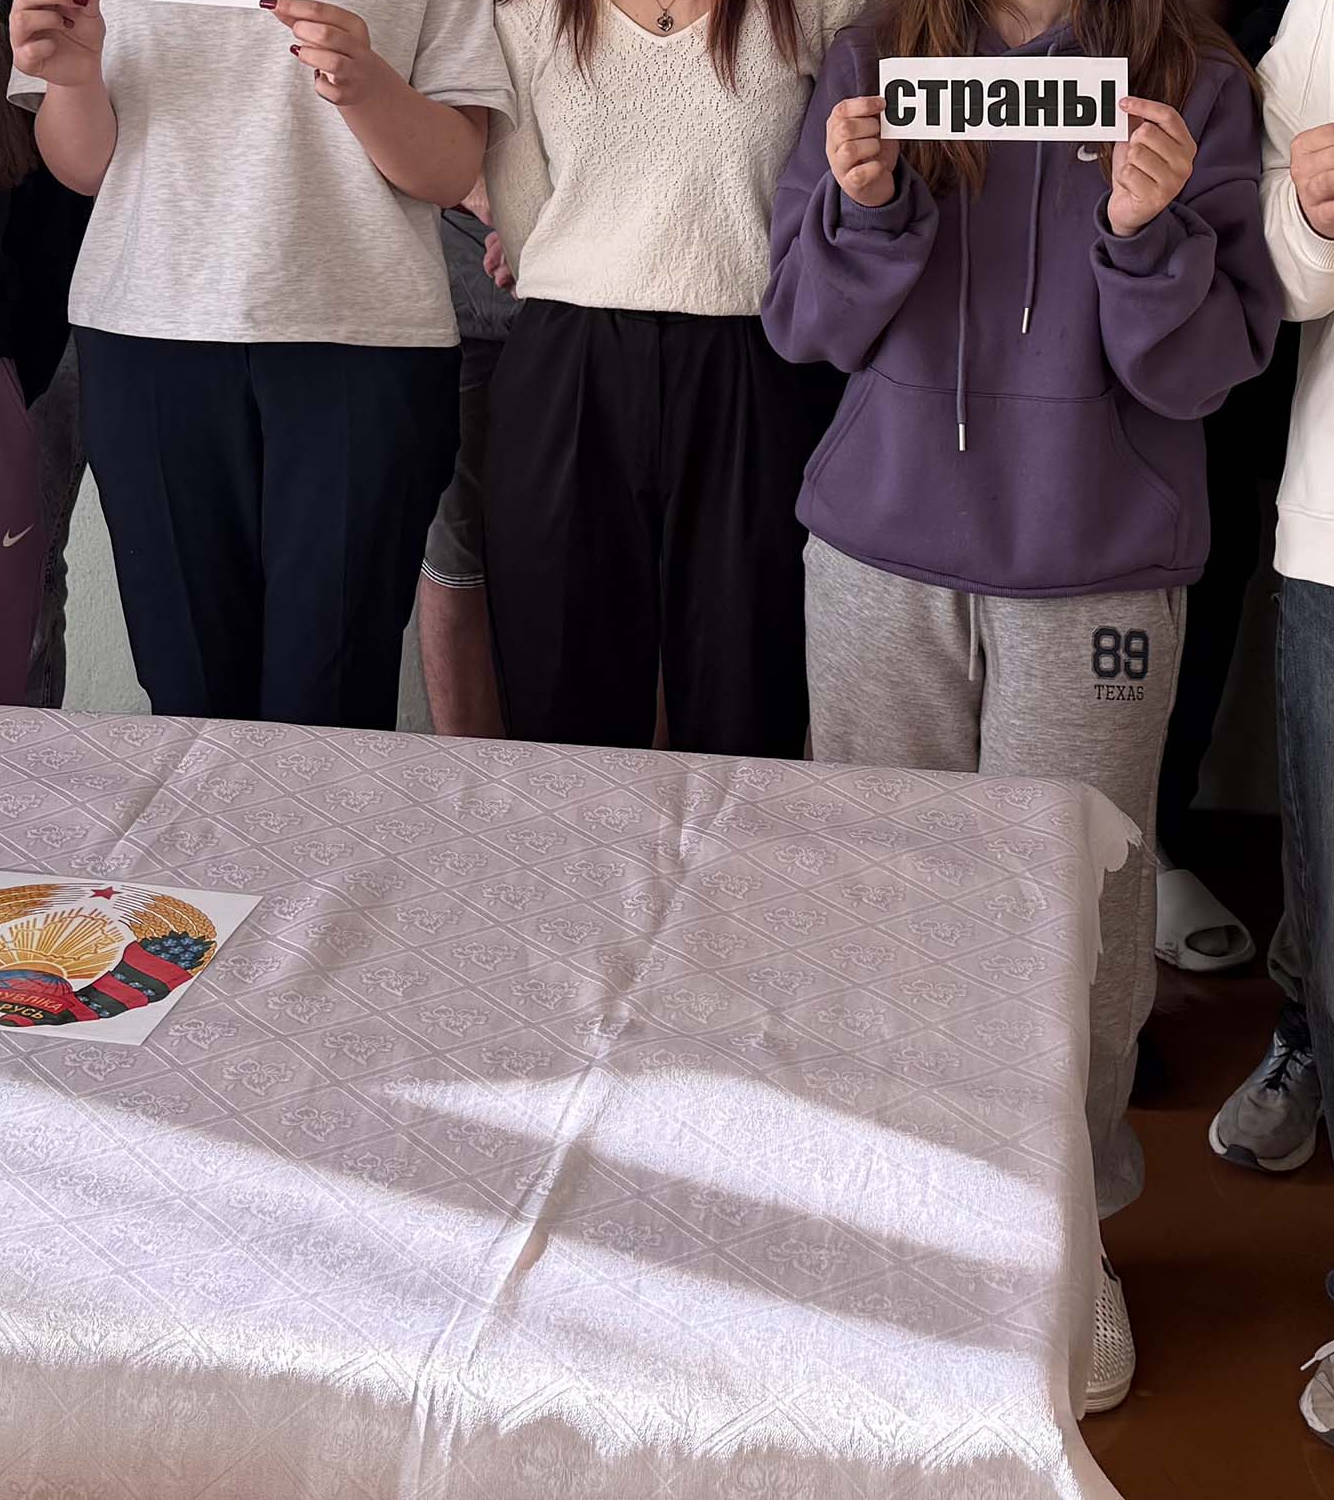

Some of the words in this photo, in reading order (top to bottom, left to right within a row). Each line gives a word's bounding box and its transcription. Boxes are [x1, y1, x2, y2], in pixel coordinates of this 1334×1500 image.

[884, 79, 1116, 132] страны
[1092, 626, 1149, 679] 89
[1094, 684, 1145, 701] TEXAS
